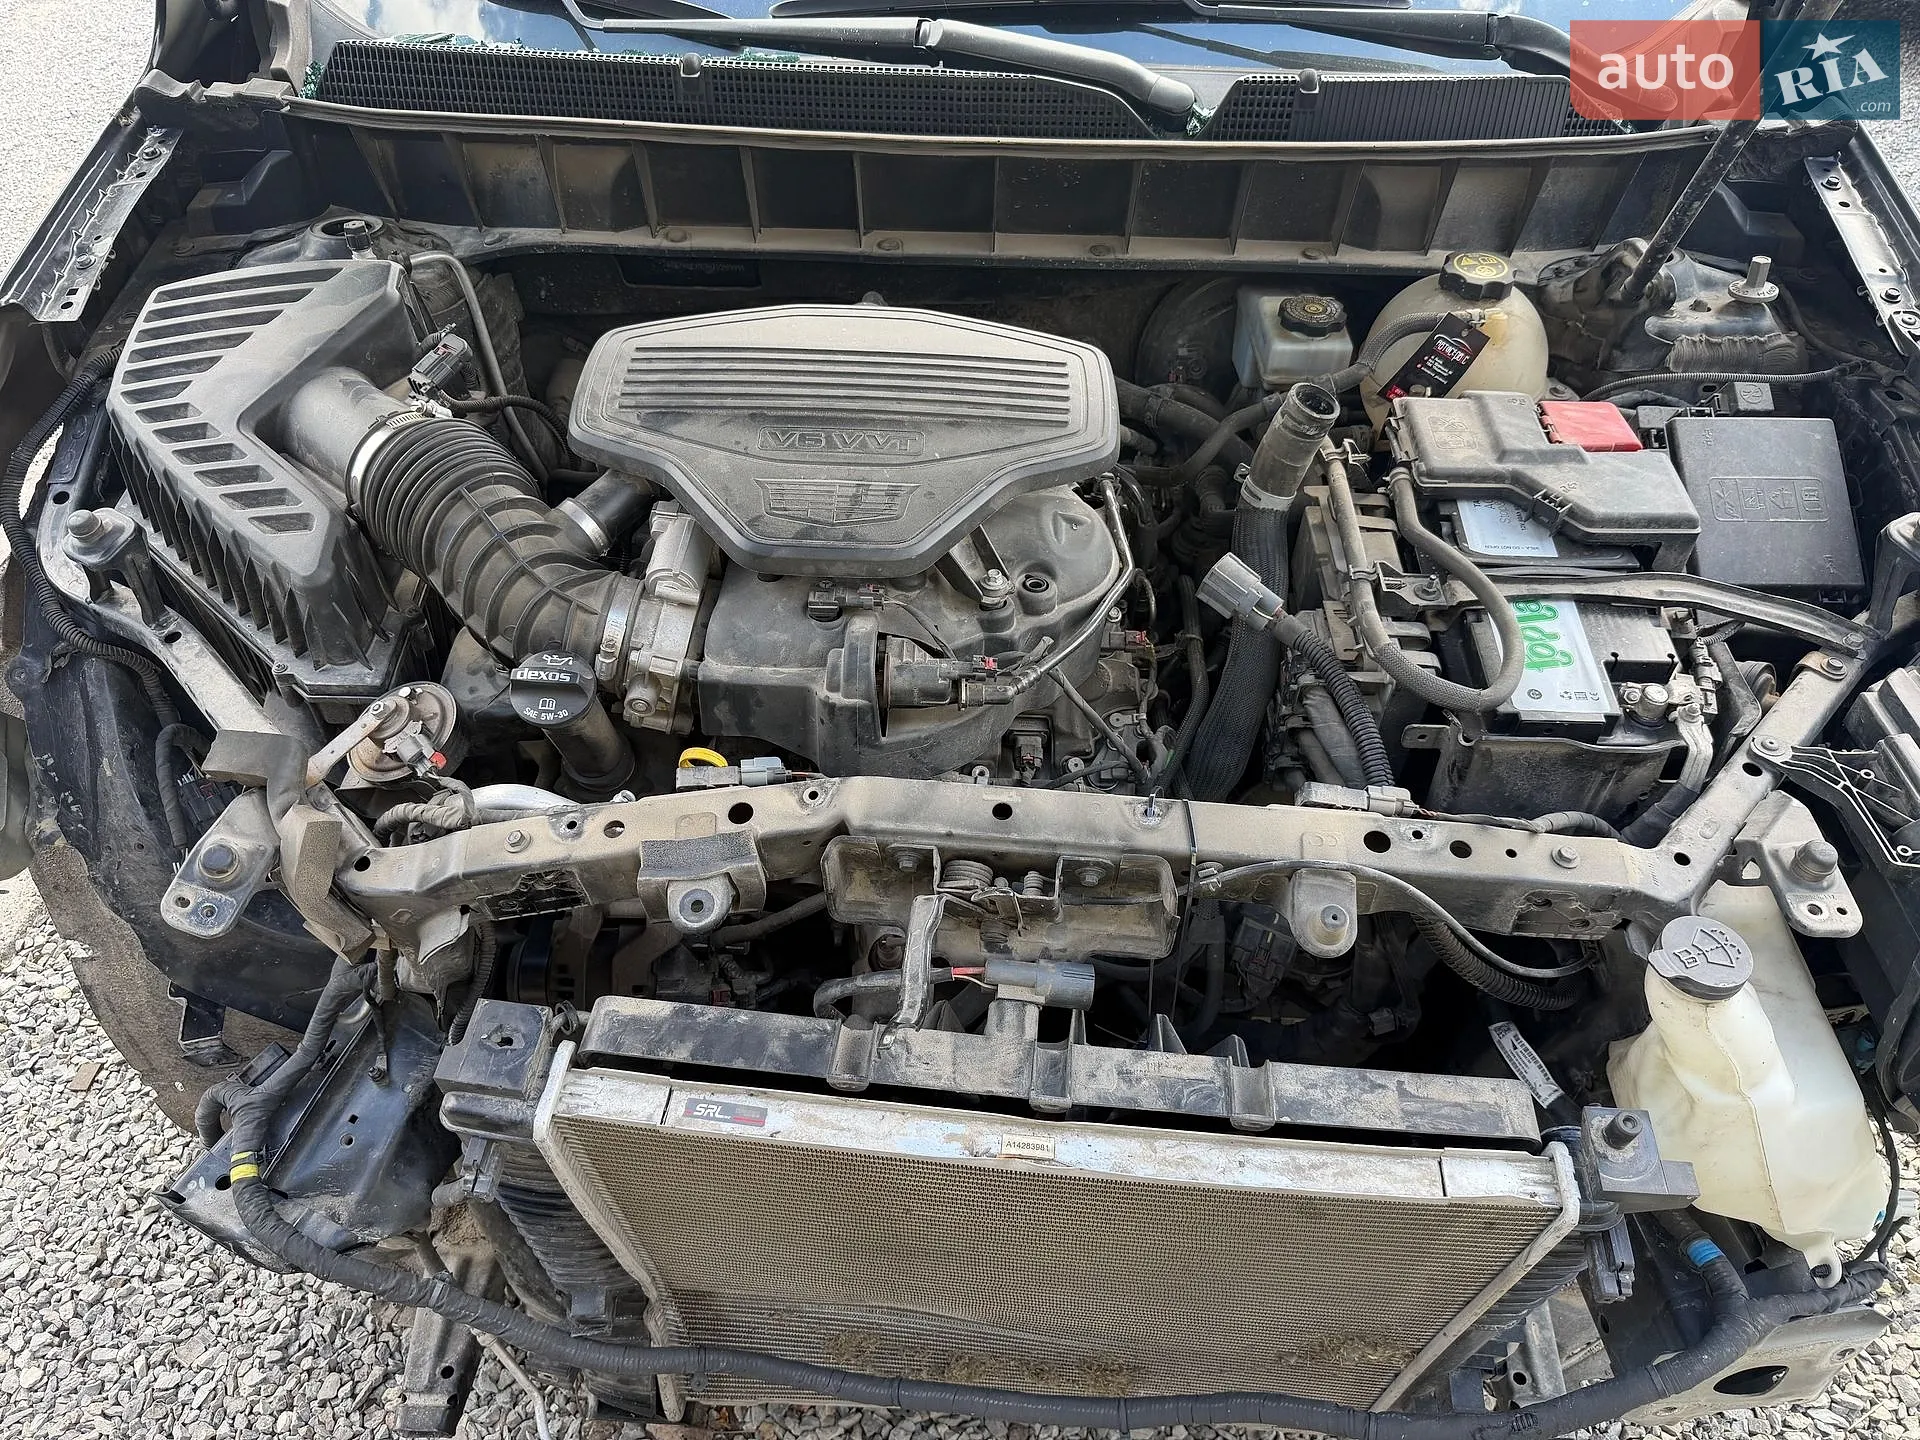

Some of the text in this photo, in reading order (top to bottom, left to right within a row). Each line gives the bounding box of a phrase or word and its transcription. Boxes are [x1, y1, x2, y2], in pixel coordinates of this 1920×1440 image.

[766, 431, 920, 451] V6 VVT
[516, 667, 571, 682] dexos
[523, 707, 569, 720] SAE 5W-30
[693, 1103, 724, 1118] SRL
